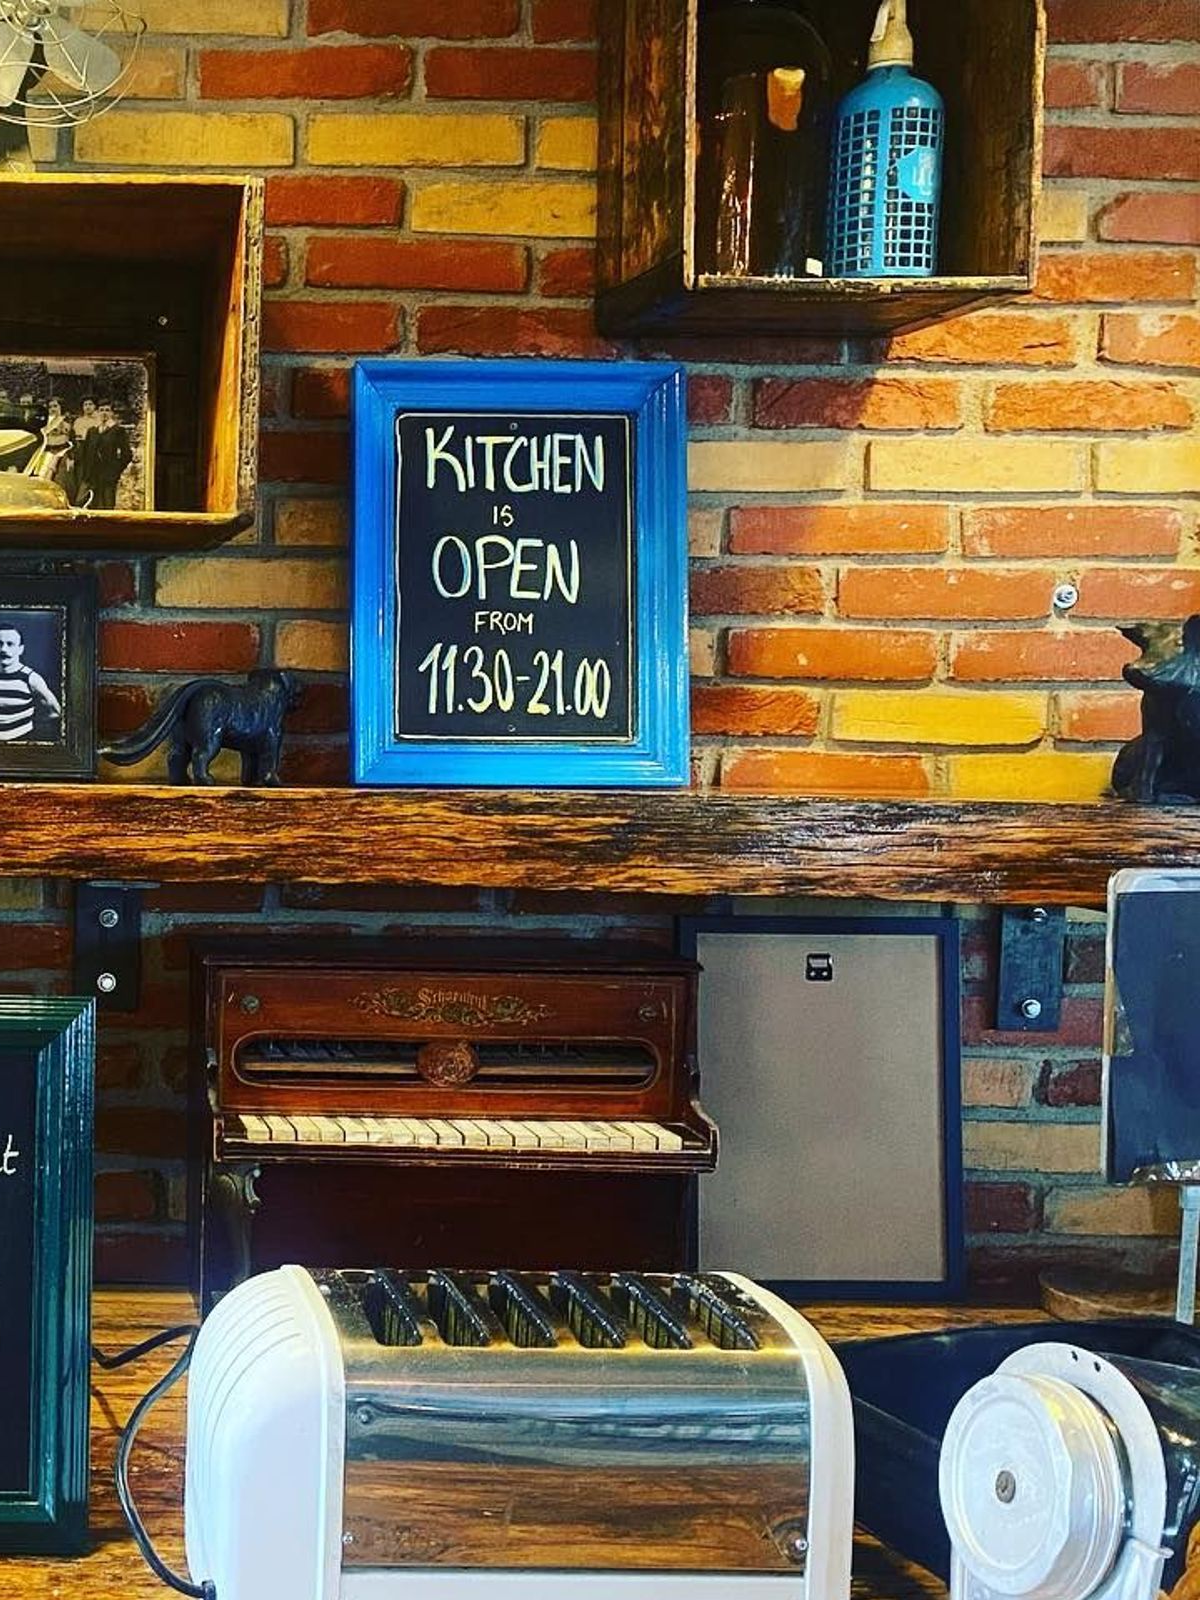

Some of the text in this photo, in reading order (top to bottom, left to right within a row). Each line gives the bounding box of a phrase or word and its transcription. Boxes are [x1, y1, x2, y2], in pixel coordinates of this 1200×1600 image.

[425, 425, 605, 494] KITCHEN
[493, 505, 514, 527] IS
[432, 535, 581, 604] OPEN
[475, 611, 534, 636] FROM
[418, 643, 612, 719] 11.30-21.00
